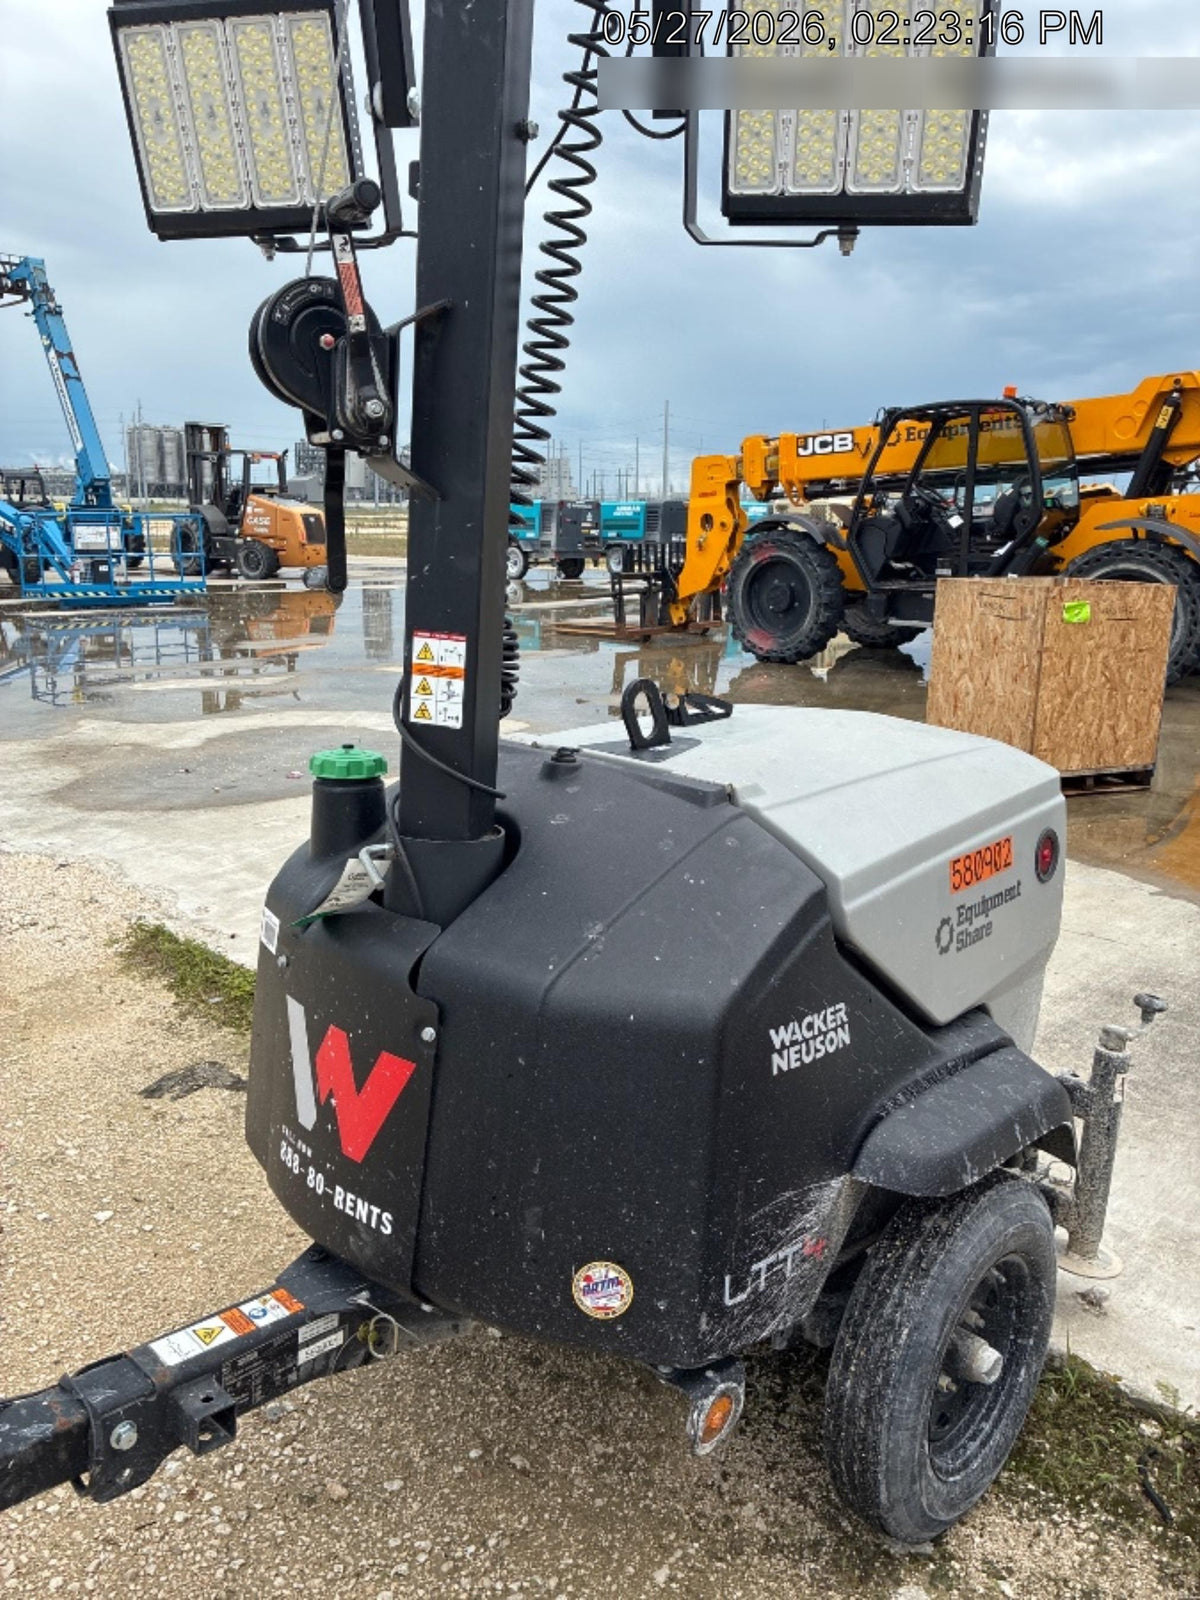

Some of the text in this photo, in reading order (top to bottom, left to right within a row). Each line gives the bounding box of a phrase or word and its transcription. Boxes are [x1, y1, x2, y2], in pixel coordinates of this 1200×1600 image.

[798, 433, 853, 456] JCB
[952, 838, 1012, 890] 580902
[956, 880, 1021, 926] Equipment
[956, 921, 993, 952] Share
[769, 1003, 848, 1049] WACKER
[771, 1024, 850, 1076] NEUSON
